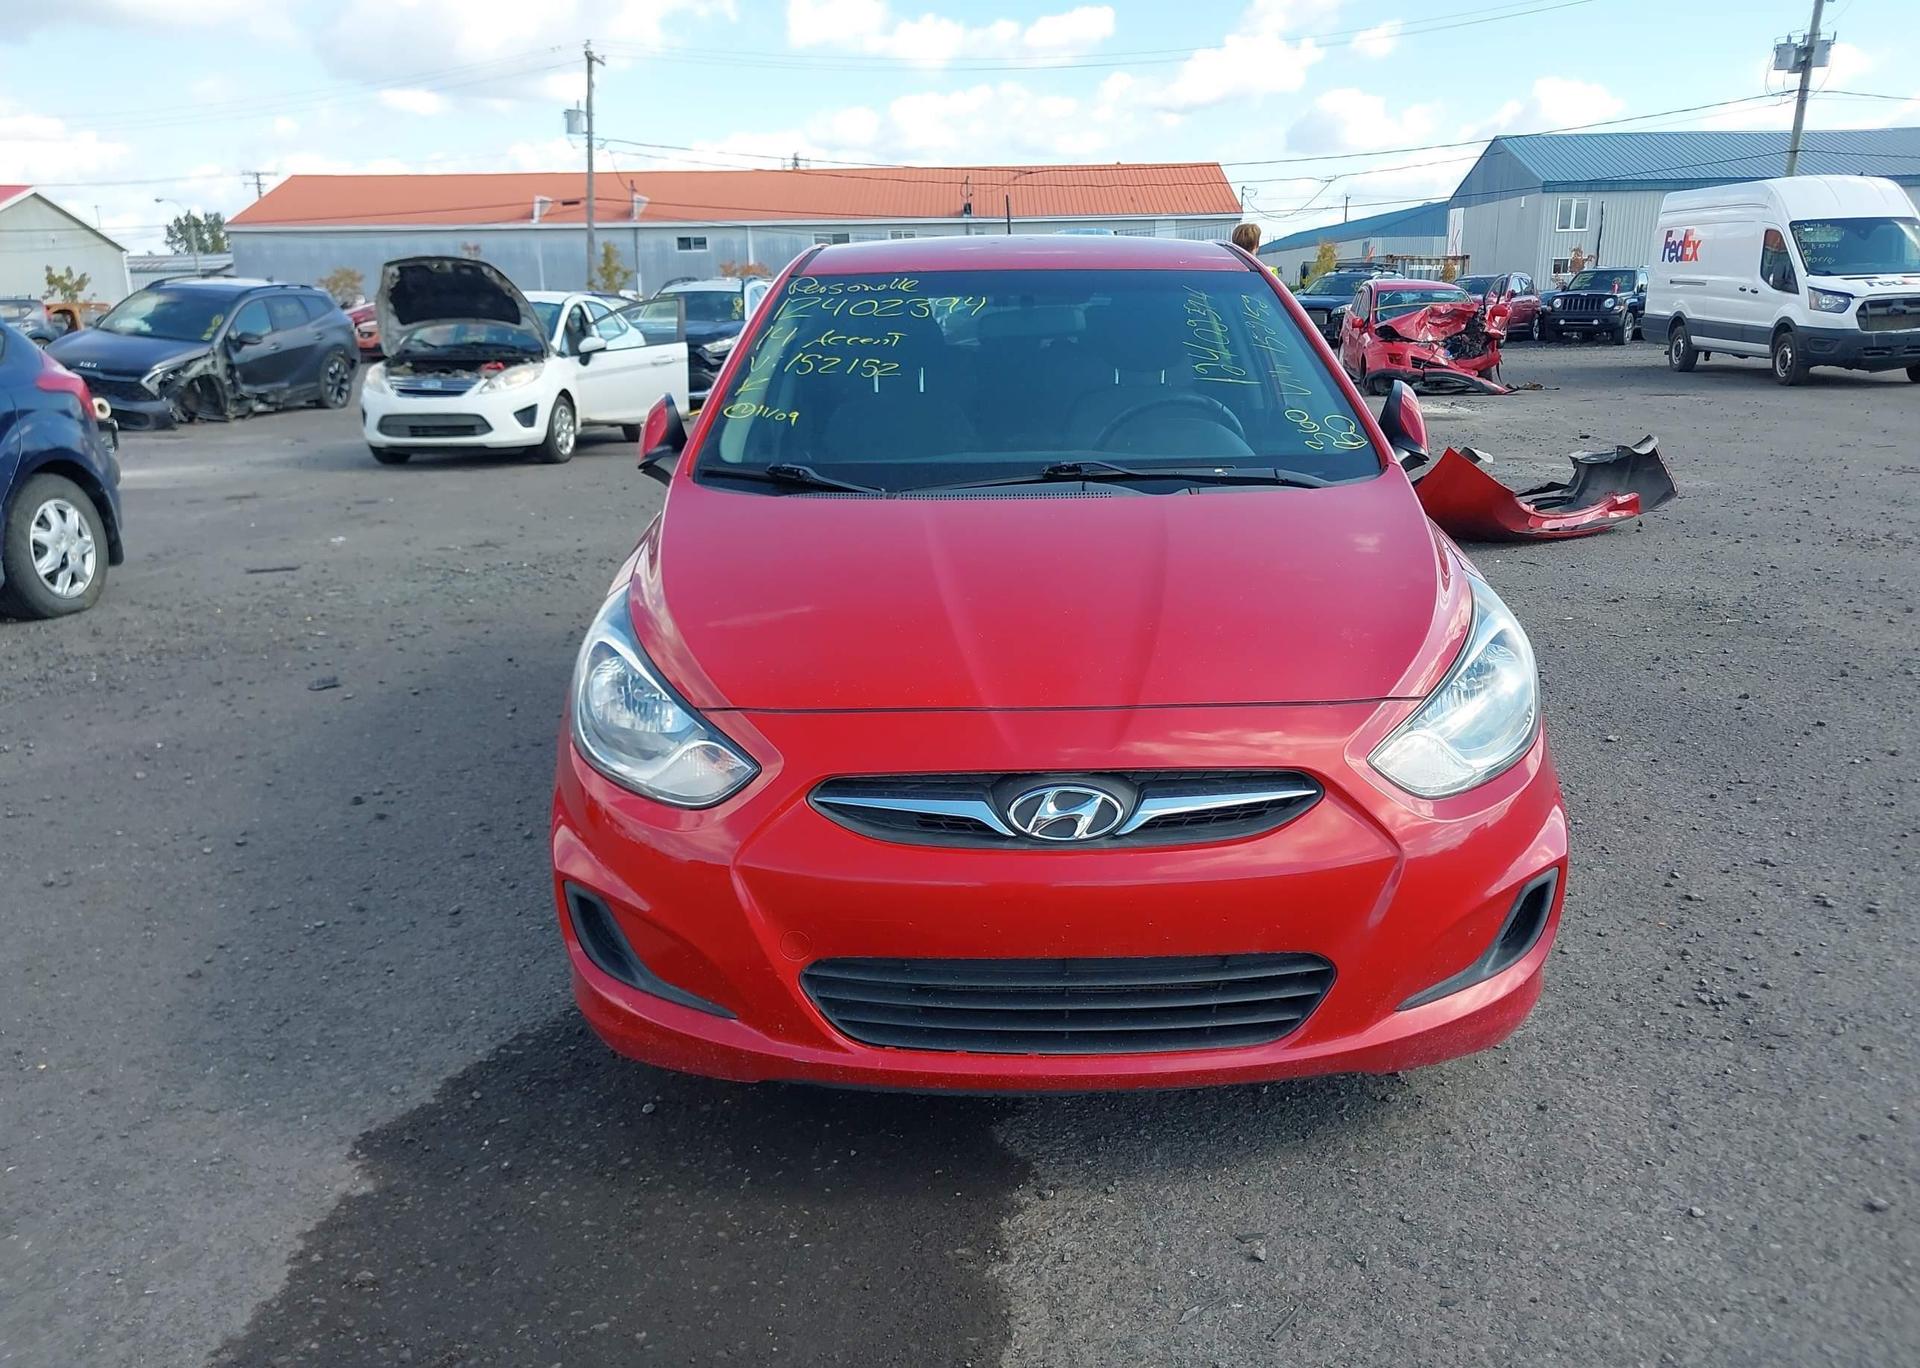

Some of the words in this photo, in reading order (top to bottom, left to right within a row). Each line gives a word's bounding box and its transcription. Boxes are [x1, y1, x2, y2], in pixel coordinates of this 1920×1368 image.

[1661, 229, 1702, 263] FedEx
[773, 296, 987, 321] 12402394
[783, 352, 902, 377] 152152
